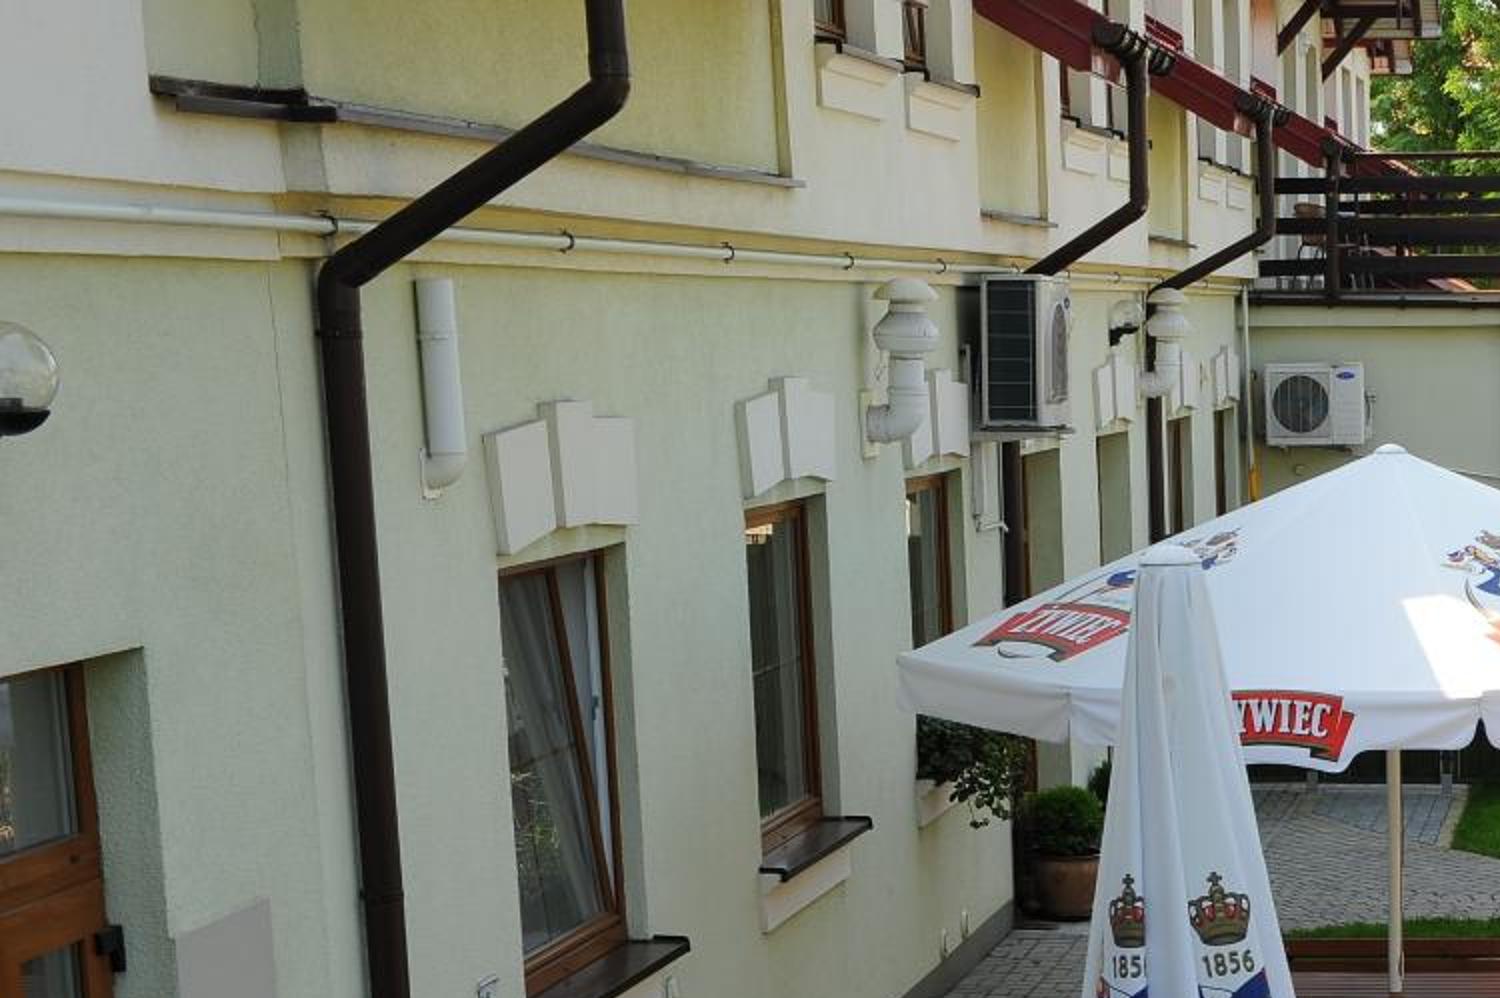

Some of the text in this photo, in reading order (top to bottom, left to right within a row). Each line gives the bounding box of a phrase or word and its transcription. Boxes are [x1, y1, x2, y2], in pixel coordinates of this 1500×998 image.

[1233, 699, 1331, 737] YWIEC
[1112, 955, 1147, 978] 185
[1203, 949, 1255, 978] 1856
